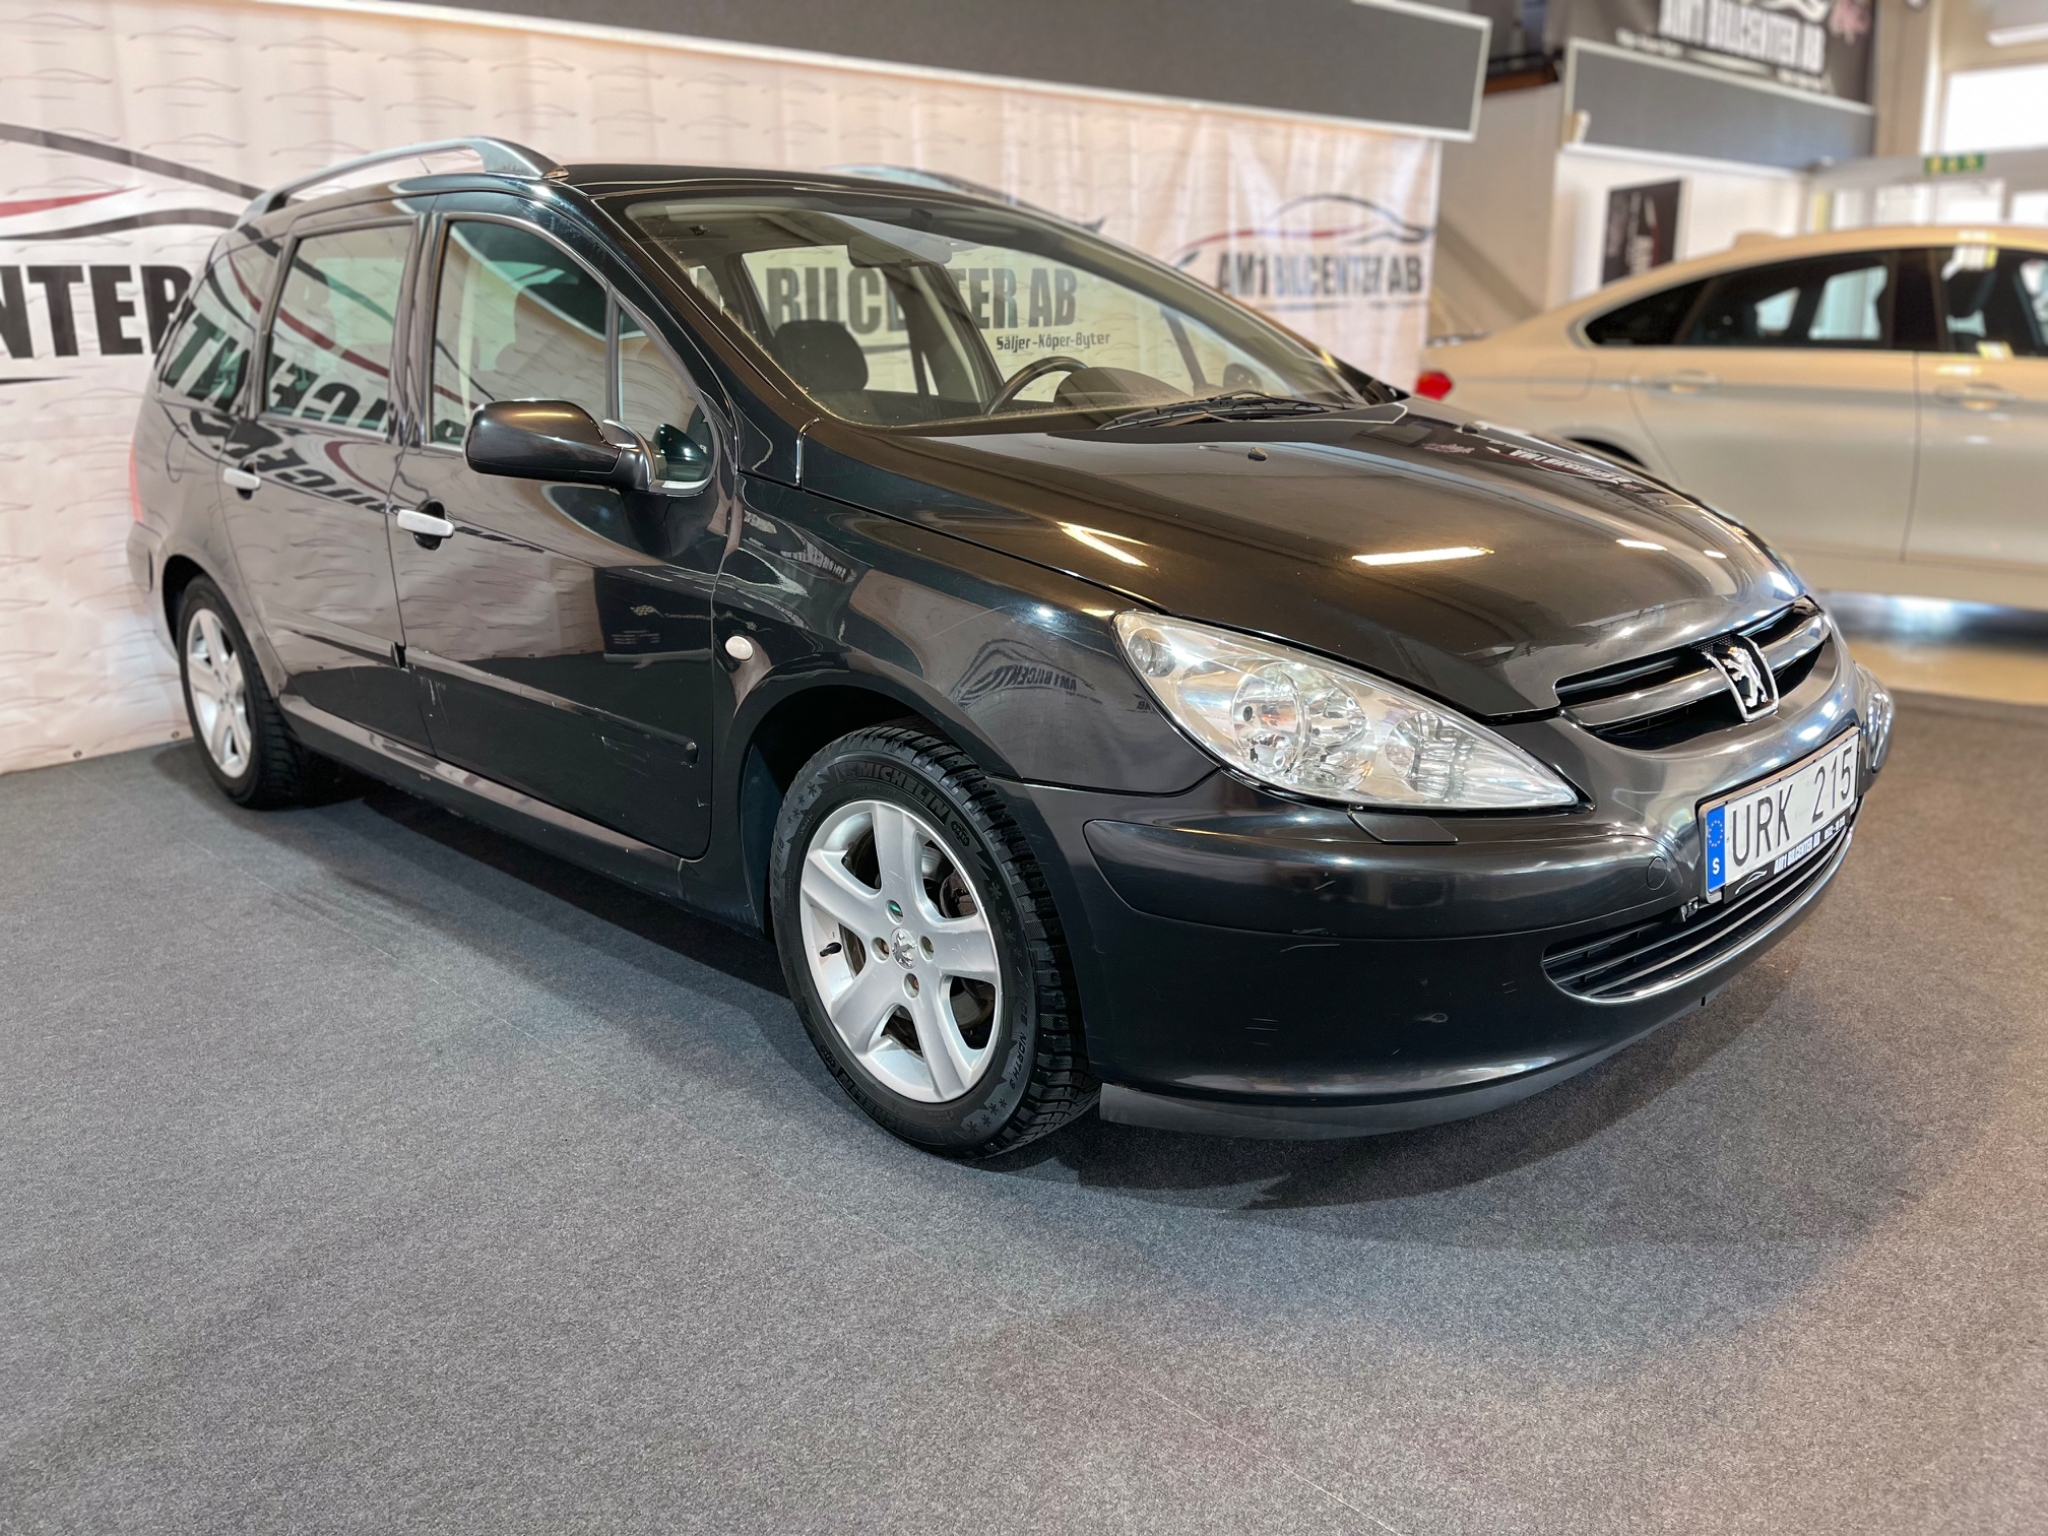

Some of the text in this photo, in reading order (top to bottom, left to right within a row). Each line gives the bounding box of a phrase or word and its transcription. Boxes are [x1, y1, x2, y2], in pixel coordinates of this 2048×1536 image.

[1028, 267, 1077, 328] AB
[857, 761, 951, 818] MICHELIN
[1712, 746, 1852, 875] S URK 215
[1012, 1031, 1027, 1080] NORTH
